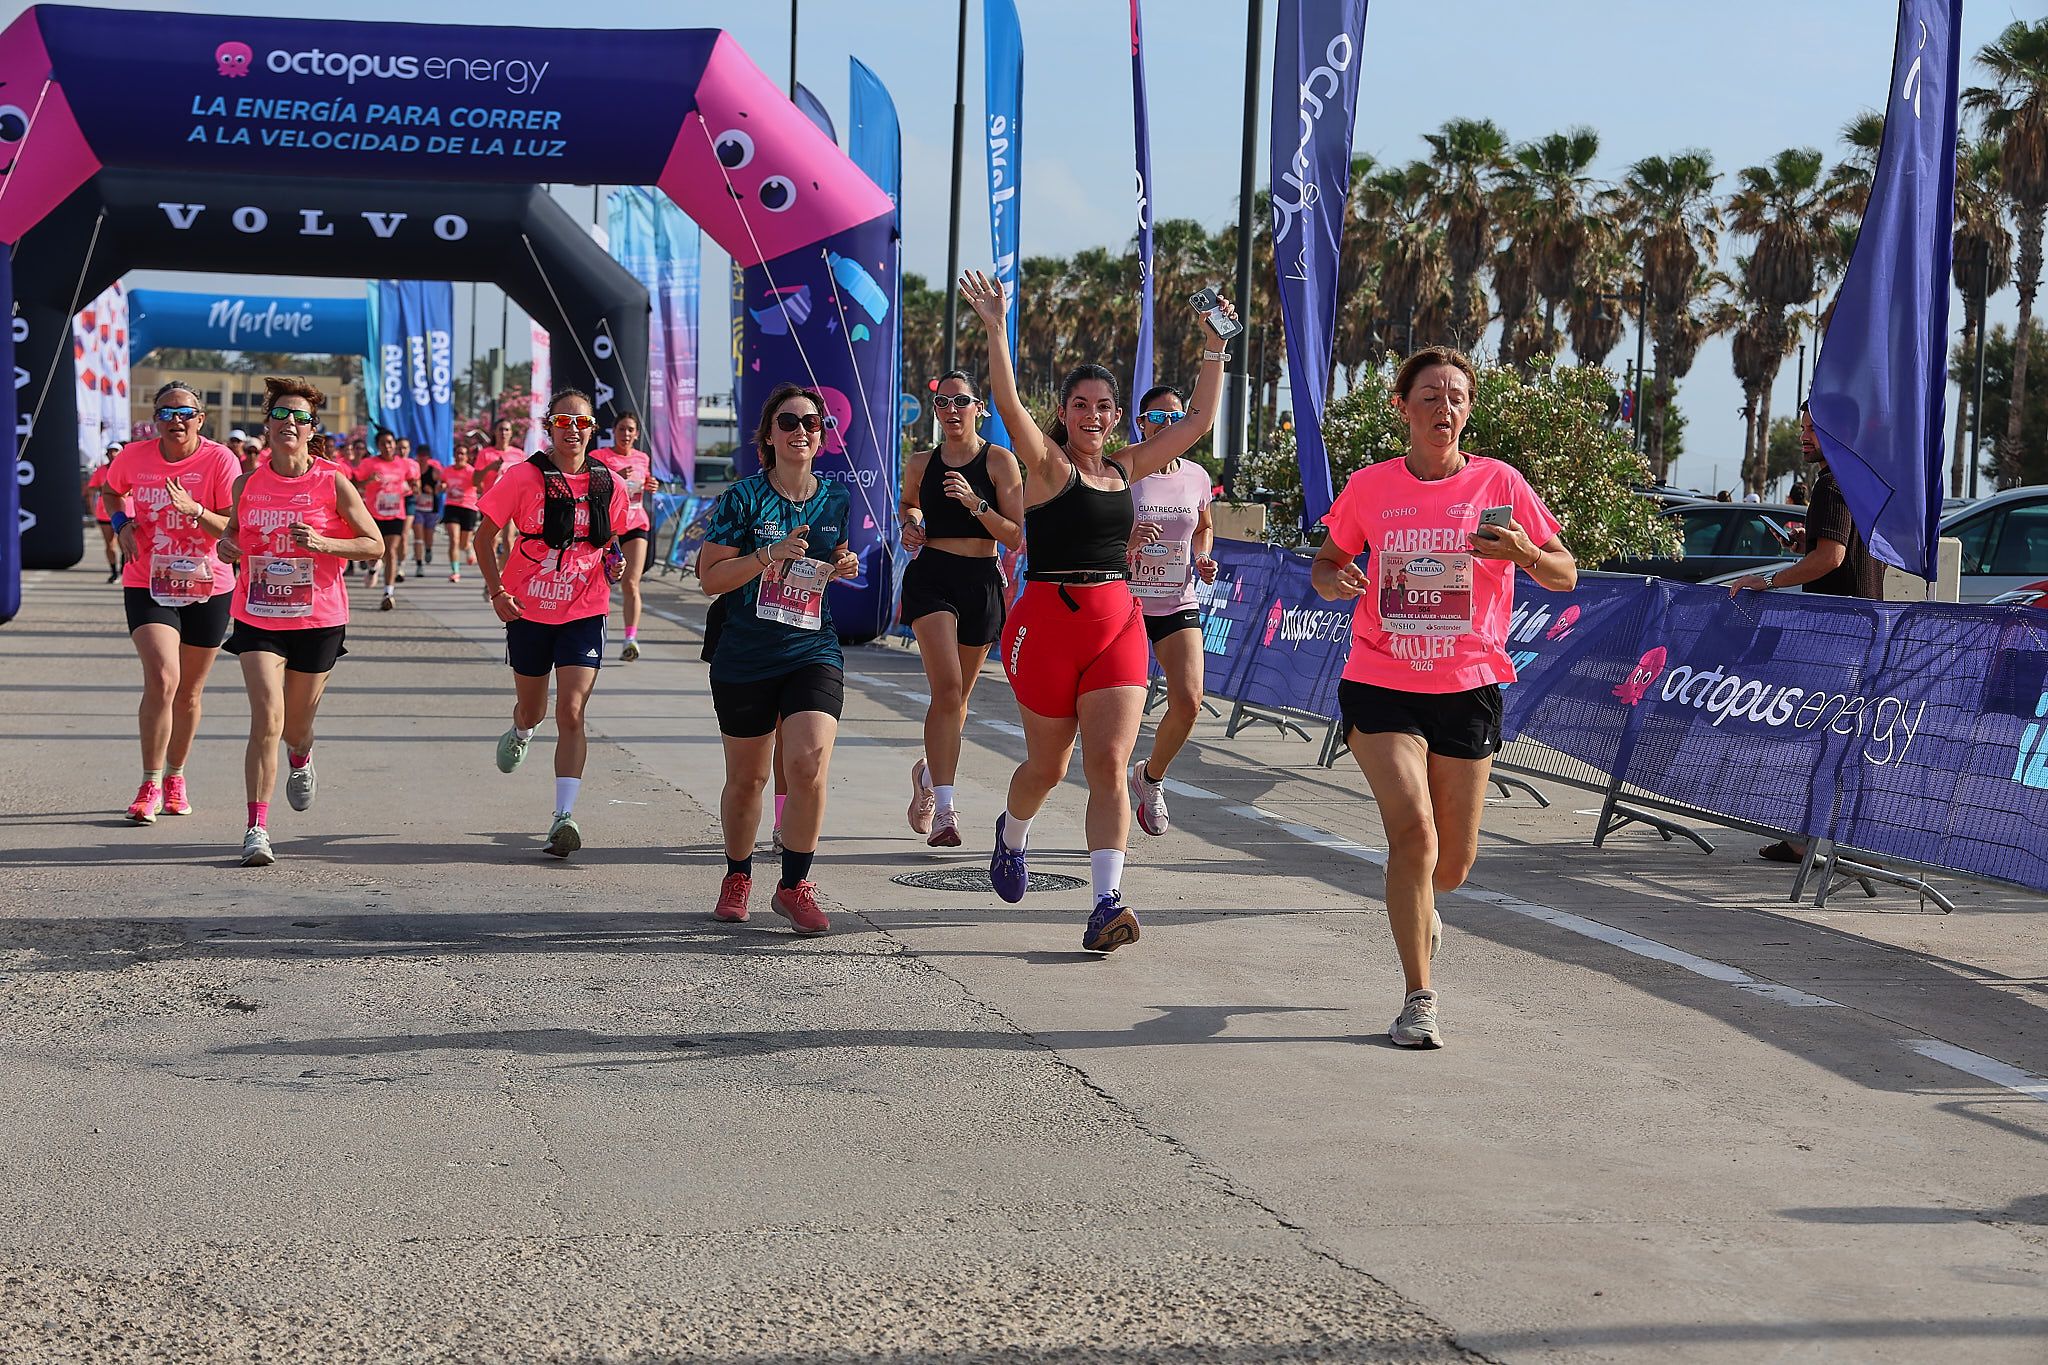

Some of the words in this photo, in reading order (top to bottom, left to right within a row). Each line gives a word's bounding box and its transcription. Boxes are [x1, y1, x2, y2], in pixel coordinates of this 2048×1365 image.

[266, 48, 419, 85] octopus
[423, 55, 550, 95] energy
[191, 95, 227, 117] LA
[235, 97, 358, 123] ENERGÍA
[365, 103, 441, 126] PARA
[449, 108, 562, 130] CORRER
[187, 125, 208, 143] A
[216, 127, 250, 145] LA
[260, 129, 420, 152] VELOCIDAD
[427, 137, 463, 155] DE
[470, 138, 504, 156] LA
[512, 140, 567, 158] LUZ
[158, 202, 468, 241] VOLVO
[827, 469, 879, 488] energy
[1138, 505, 1192, 514] CUATRECASAS
[1381, 507, 1417, 519] OYSHO
[1142, 565, 1166, 576] 016
[1408, 564, 1443, 573] ASTURIANA
[170, 580, 195, 588] 016
[267, 584, 293, 595] 016
[527, 577, 574, 601] MUJER
[783, 585, 811, 602] 016
[1407, 590, 1442, 604] 016
[1390, 621, 1416, 630] OYSHO
[1390, 635, 1456, 660] MUJER
[1410, 660, 1434, 672] 2026
[1661, 664, 1804, 727] octopus
[1793, 690, 1927, 769] energy
